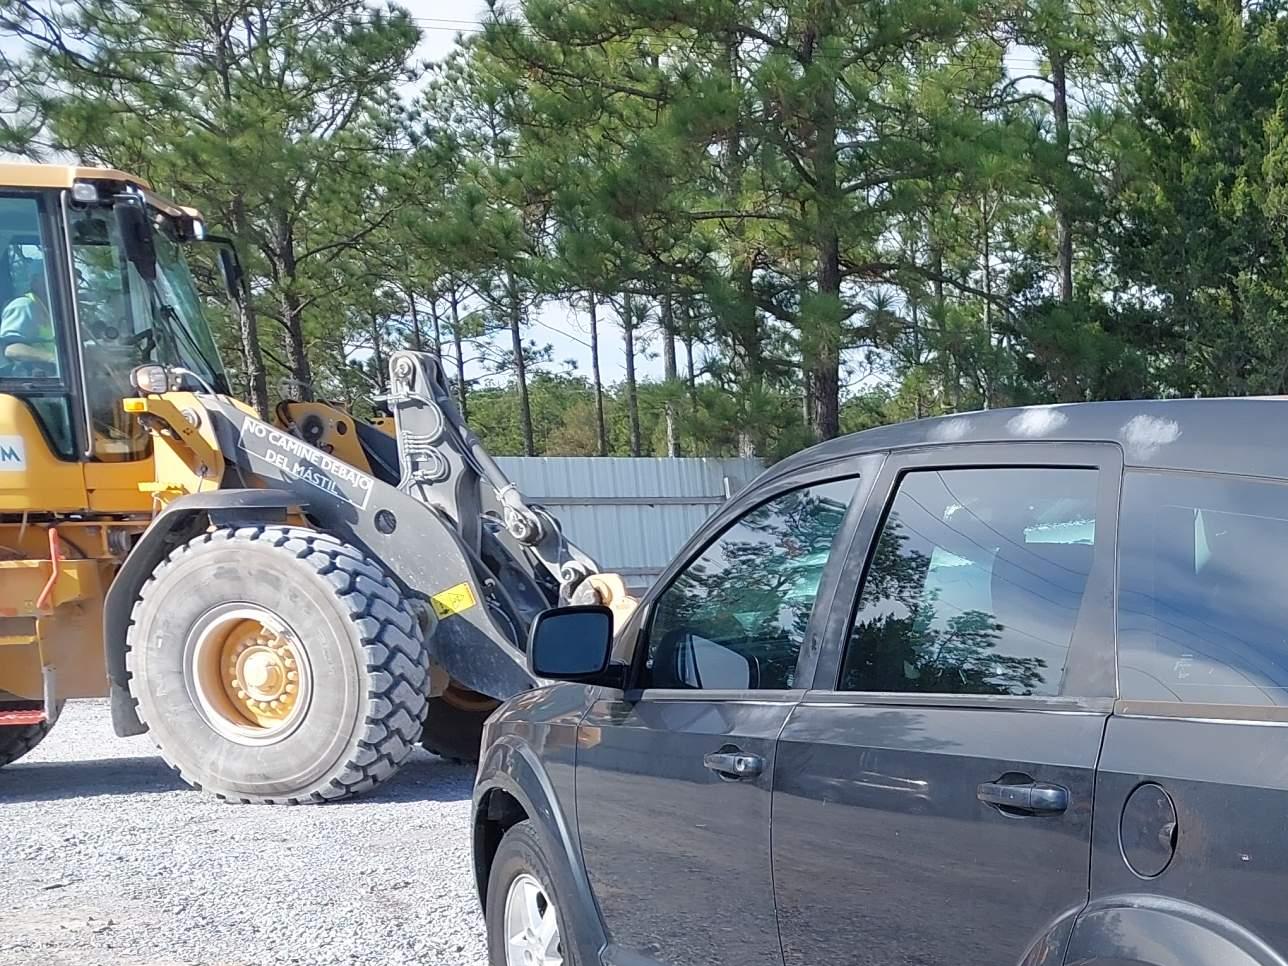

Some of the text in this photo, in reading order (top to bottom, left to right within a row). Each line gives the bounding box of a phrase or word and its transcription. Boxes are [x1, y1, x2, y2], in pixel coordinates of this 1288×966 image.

[245, 420, 371, 489] NO CAMINE DEBAJO
[264, 449, 339, 495] DEL MÁSTIL
